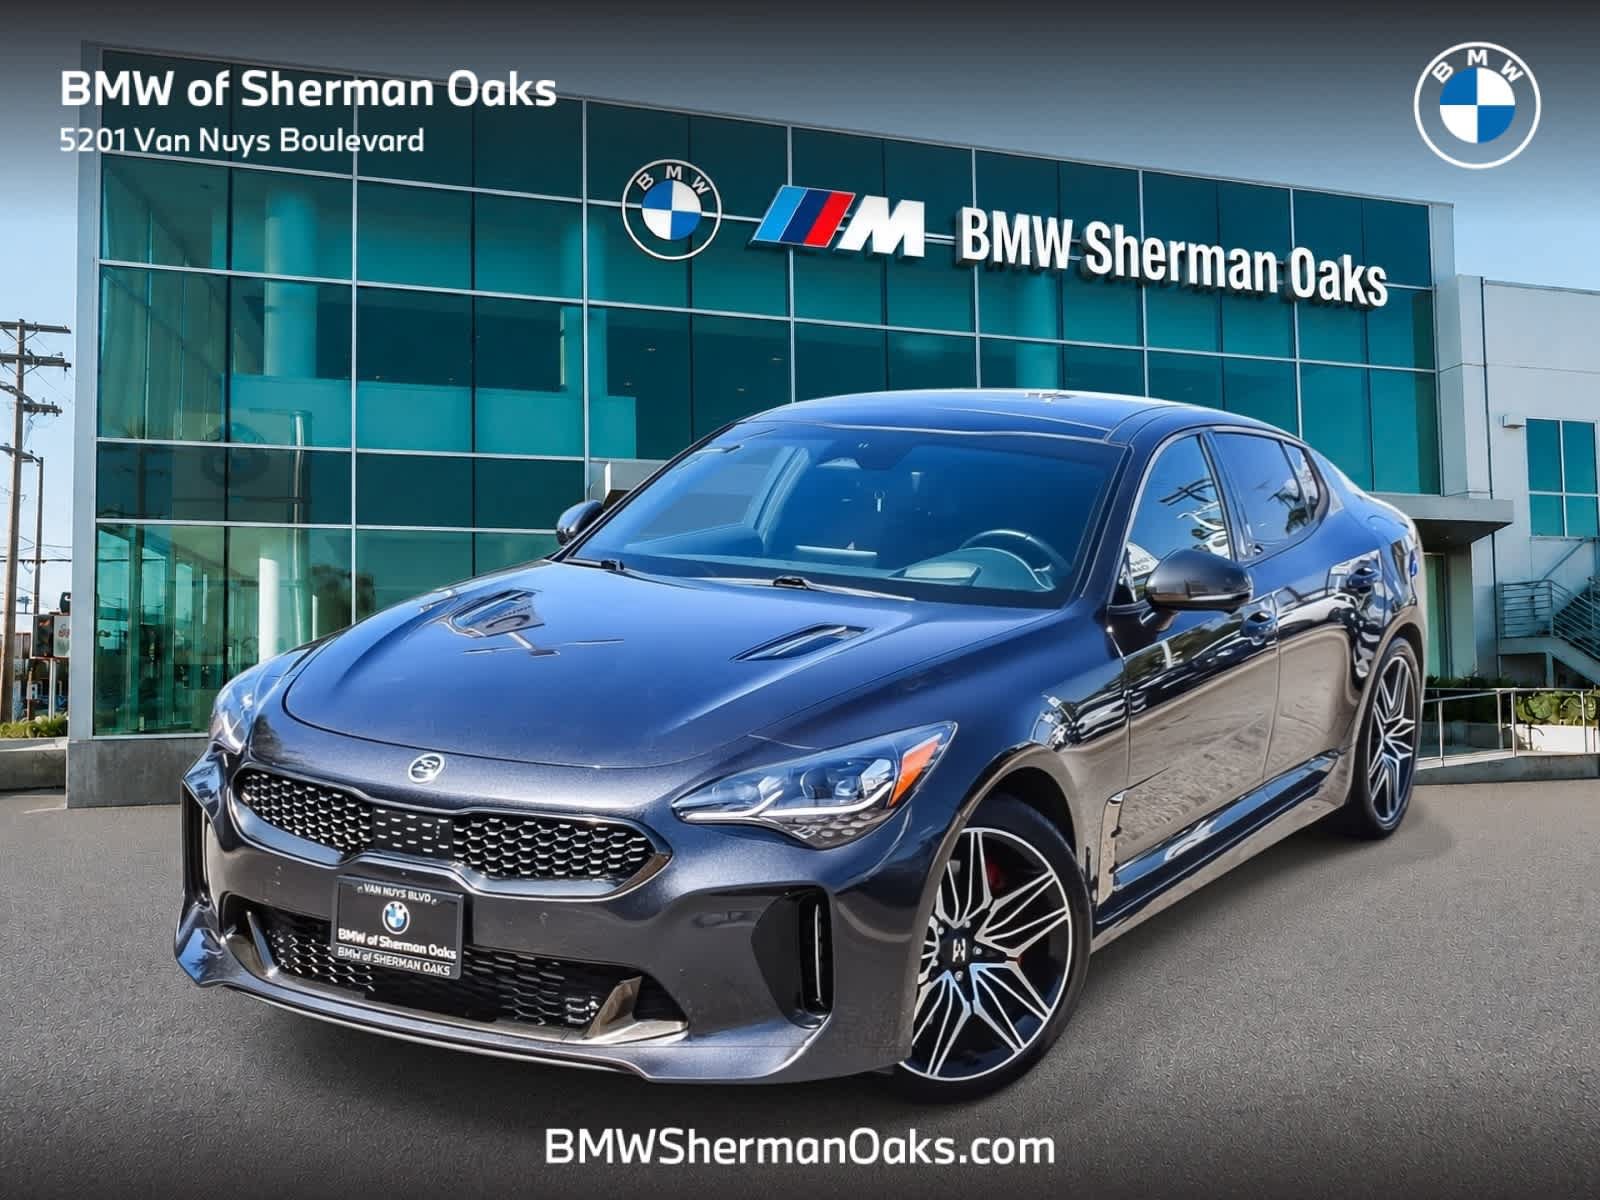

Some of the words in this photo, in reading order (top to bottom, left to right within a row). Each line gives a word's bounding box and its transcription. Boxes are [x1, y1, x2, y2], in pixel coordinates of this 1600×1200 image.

[636, 165, 711, 195] BMW
[961, 206, 1073, 270] BMW
[1085, 220, 1278, 294] Sherman
[1291, 246, 1389, 308] Oaks
[364, 883, 382, 894] VAN
[383, 886, 407, 898] NUYS
[408, 890, 432, 903] BLVD
[338, 928, 365, 944] BMW
[367, 935, 379, 947] of
[379, 936, 428, 955] Sherman
[428, 944, 457, 959] Oaks
[337, 946, 361, 960] BMW
[362, 952, 373, 962] of
[373, 953, 422, 971] SHERMAN
[423, 962, 451, 976] OAKS
